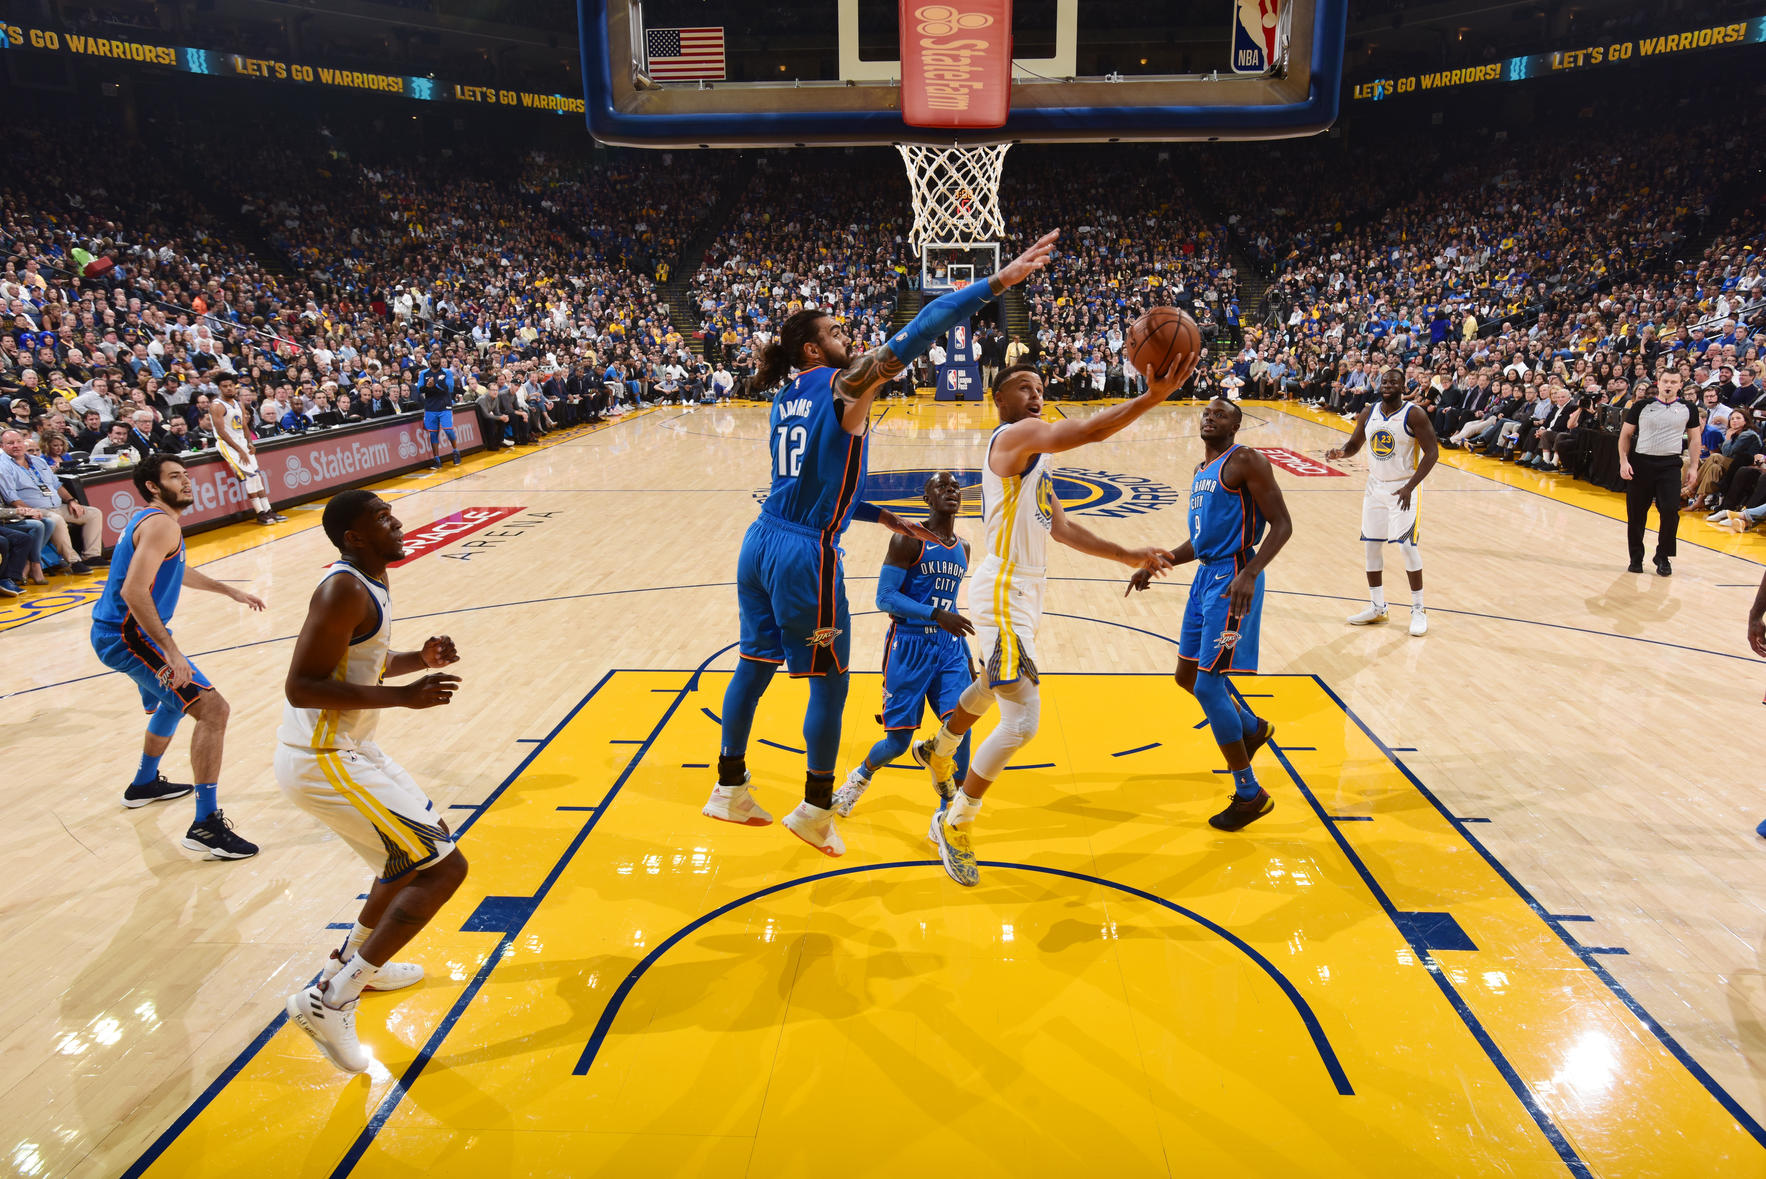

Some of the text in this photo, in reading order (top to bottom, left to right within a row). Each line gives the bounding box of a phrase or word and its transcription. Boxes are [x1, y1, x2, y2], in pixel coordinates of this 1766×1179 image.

[29, 28, 60, 50] GO
[64, 33, 177, 65] WARRIORS!
[1238, 49, 1259, 66] NBA
[1552, 22, 1747, 70] LET'S GO WARRIORS!
[233, 55, 403, 93] LET'S GO WARRIORS!
[919, 38, 990, 111] StateFarm
[1353, 63, 1501, 100] LET'S GO WARRIORS!
[454, 84, 585, 113] LET'S GO WARRIORS
[777, 425, 807, 477] 12
[1381, 434, 1392, 443] 23
[310, 442, 390, 482] StateFarm
[1191, 495, 1204, 511] CITY
[440, 510, 563, 561] ARENA
[1194, 515, 1201, 540] 9
[935, 577, 957, 593] CITY
